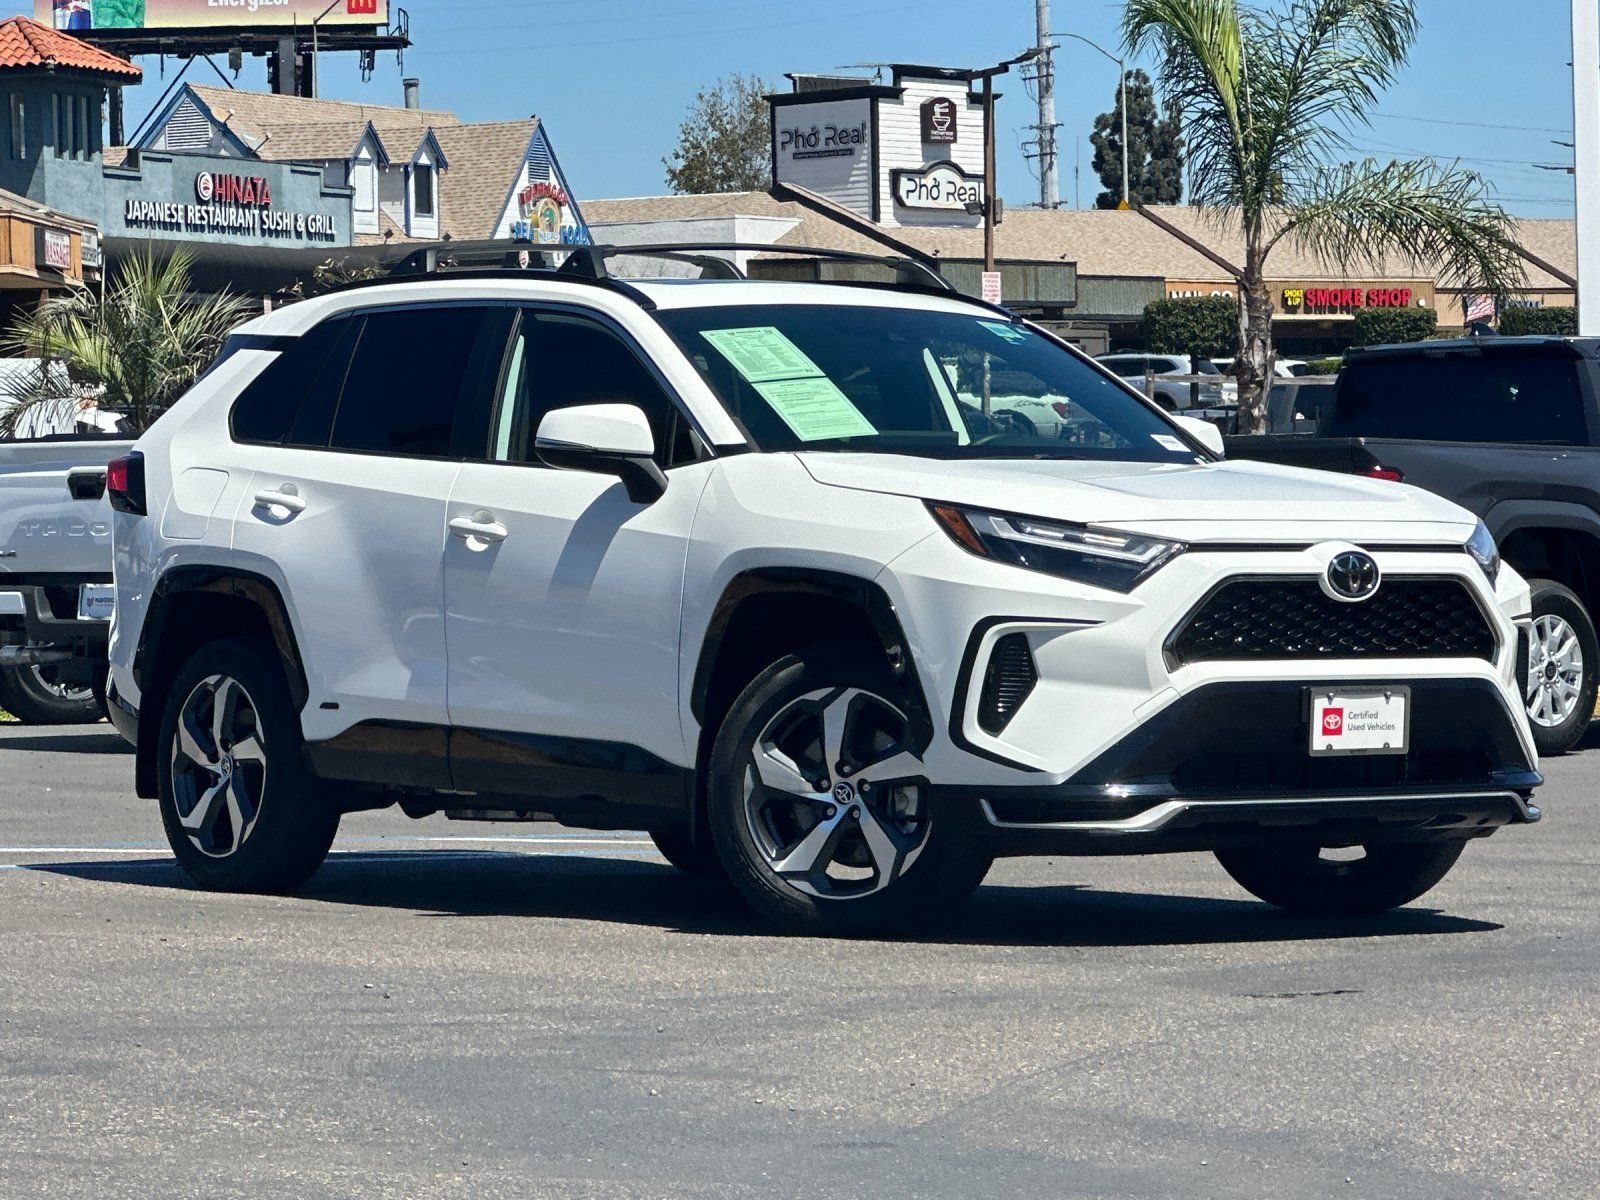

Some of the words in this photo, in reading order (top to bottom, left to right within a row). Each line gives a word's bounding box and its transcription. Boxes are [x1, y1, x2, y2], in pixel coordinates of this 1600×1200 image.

[825, 121, 866, 146] Real
[214, 173, 272, 205] HINATA
[946, 180, 981, 203] Real
[126, 200, 184, 224] JAPANESE
[187, 205, 260, 229] RESTAURANT
[262, 210, 294, 232] SUSHI
[297, 213, 305, 231] &
[308, 214, 337, 235] GRILL
[1284, 289, 1303, 298] SMOKE
[1305, 288, 1364, 308] SMOKE
[1368, 288, 1412, 308] SHOP
[1348, 710, 1379, 720] Certified
[1347, 723, 1365, 731] Used
[1367, 722, 1395, 731] Vehicles
